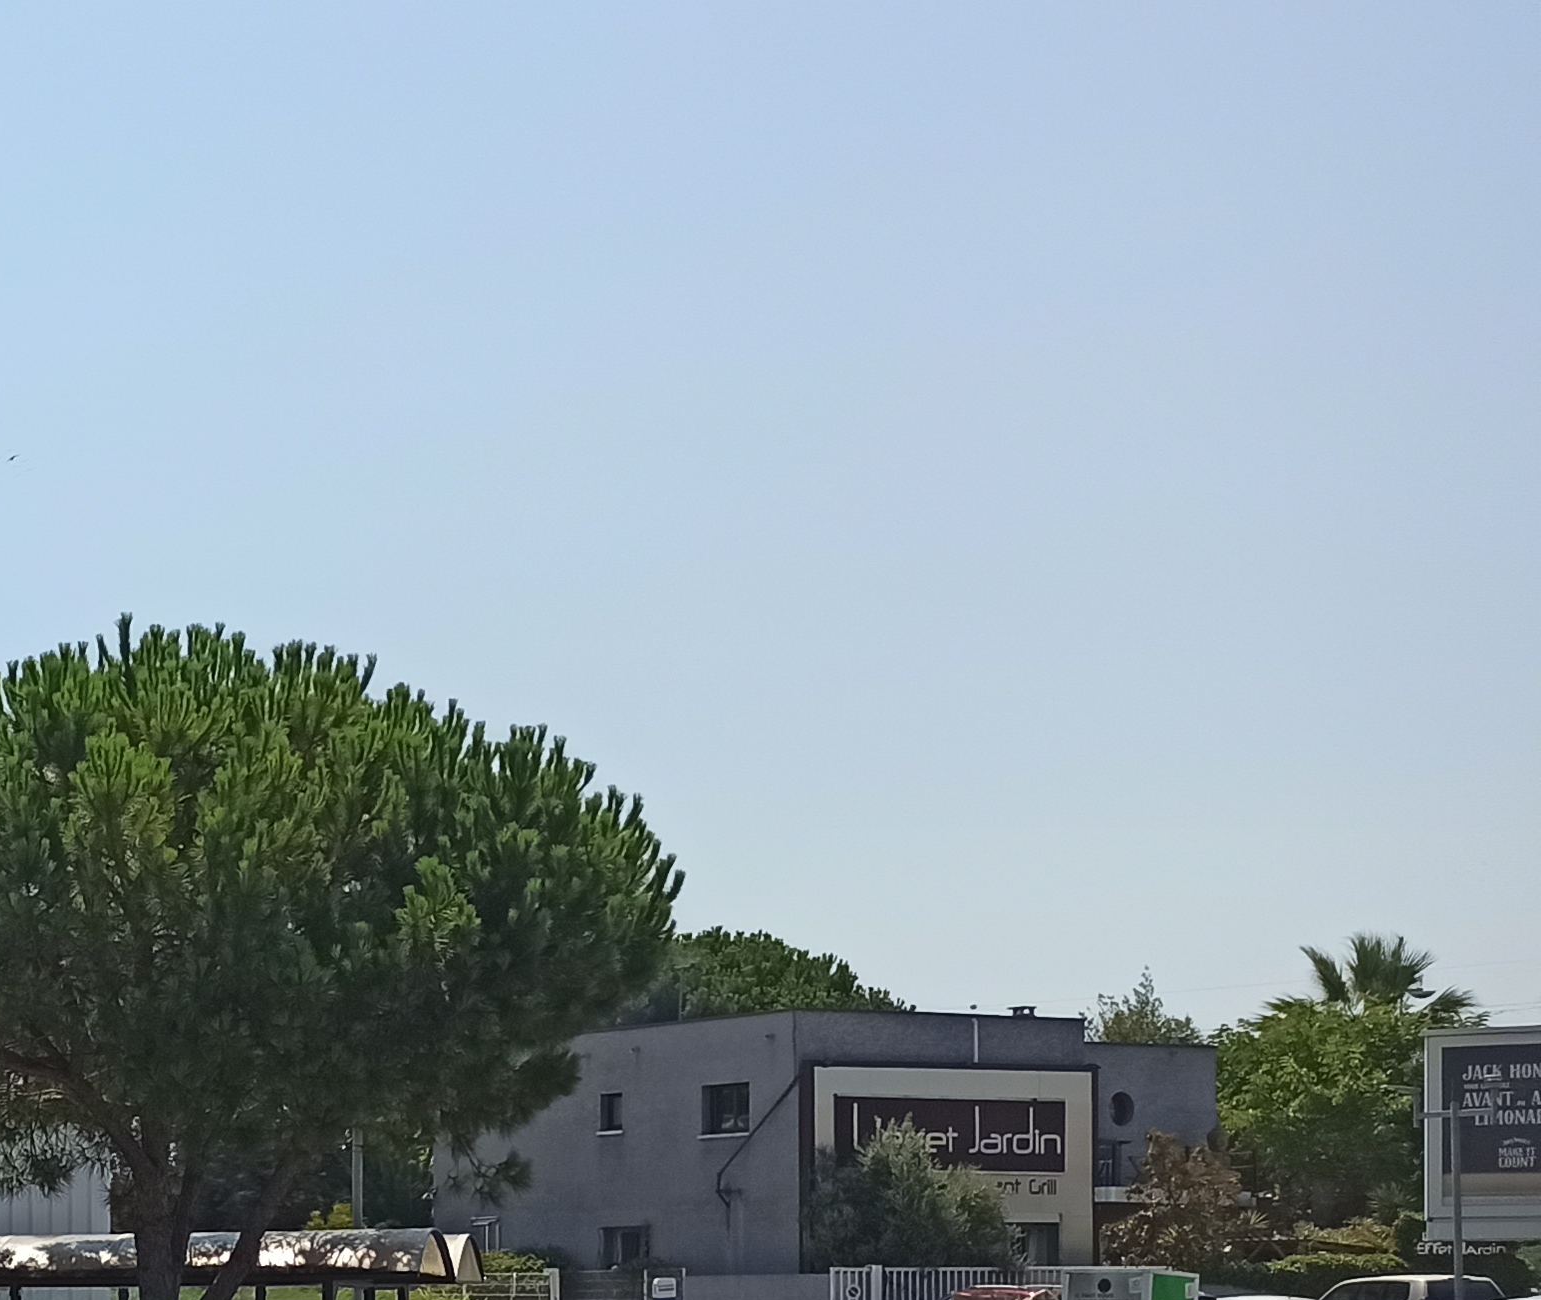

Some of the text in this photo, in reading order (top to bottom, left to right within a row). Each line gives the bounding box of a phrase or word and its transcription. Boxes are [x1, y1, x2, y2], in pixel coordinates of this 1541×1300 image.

[1462, 1064, 1502, 1080] JACK
[968, 1105, 1062, 1154] Jardin
[1028, 1179, 1057, 1195] Grill
